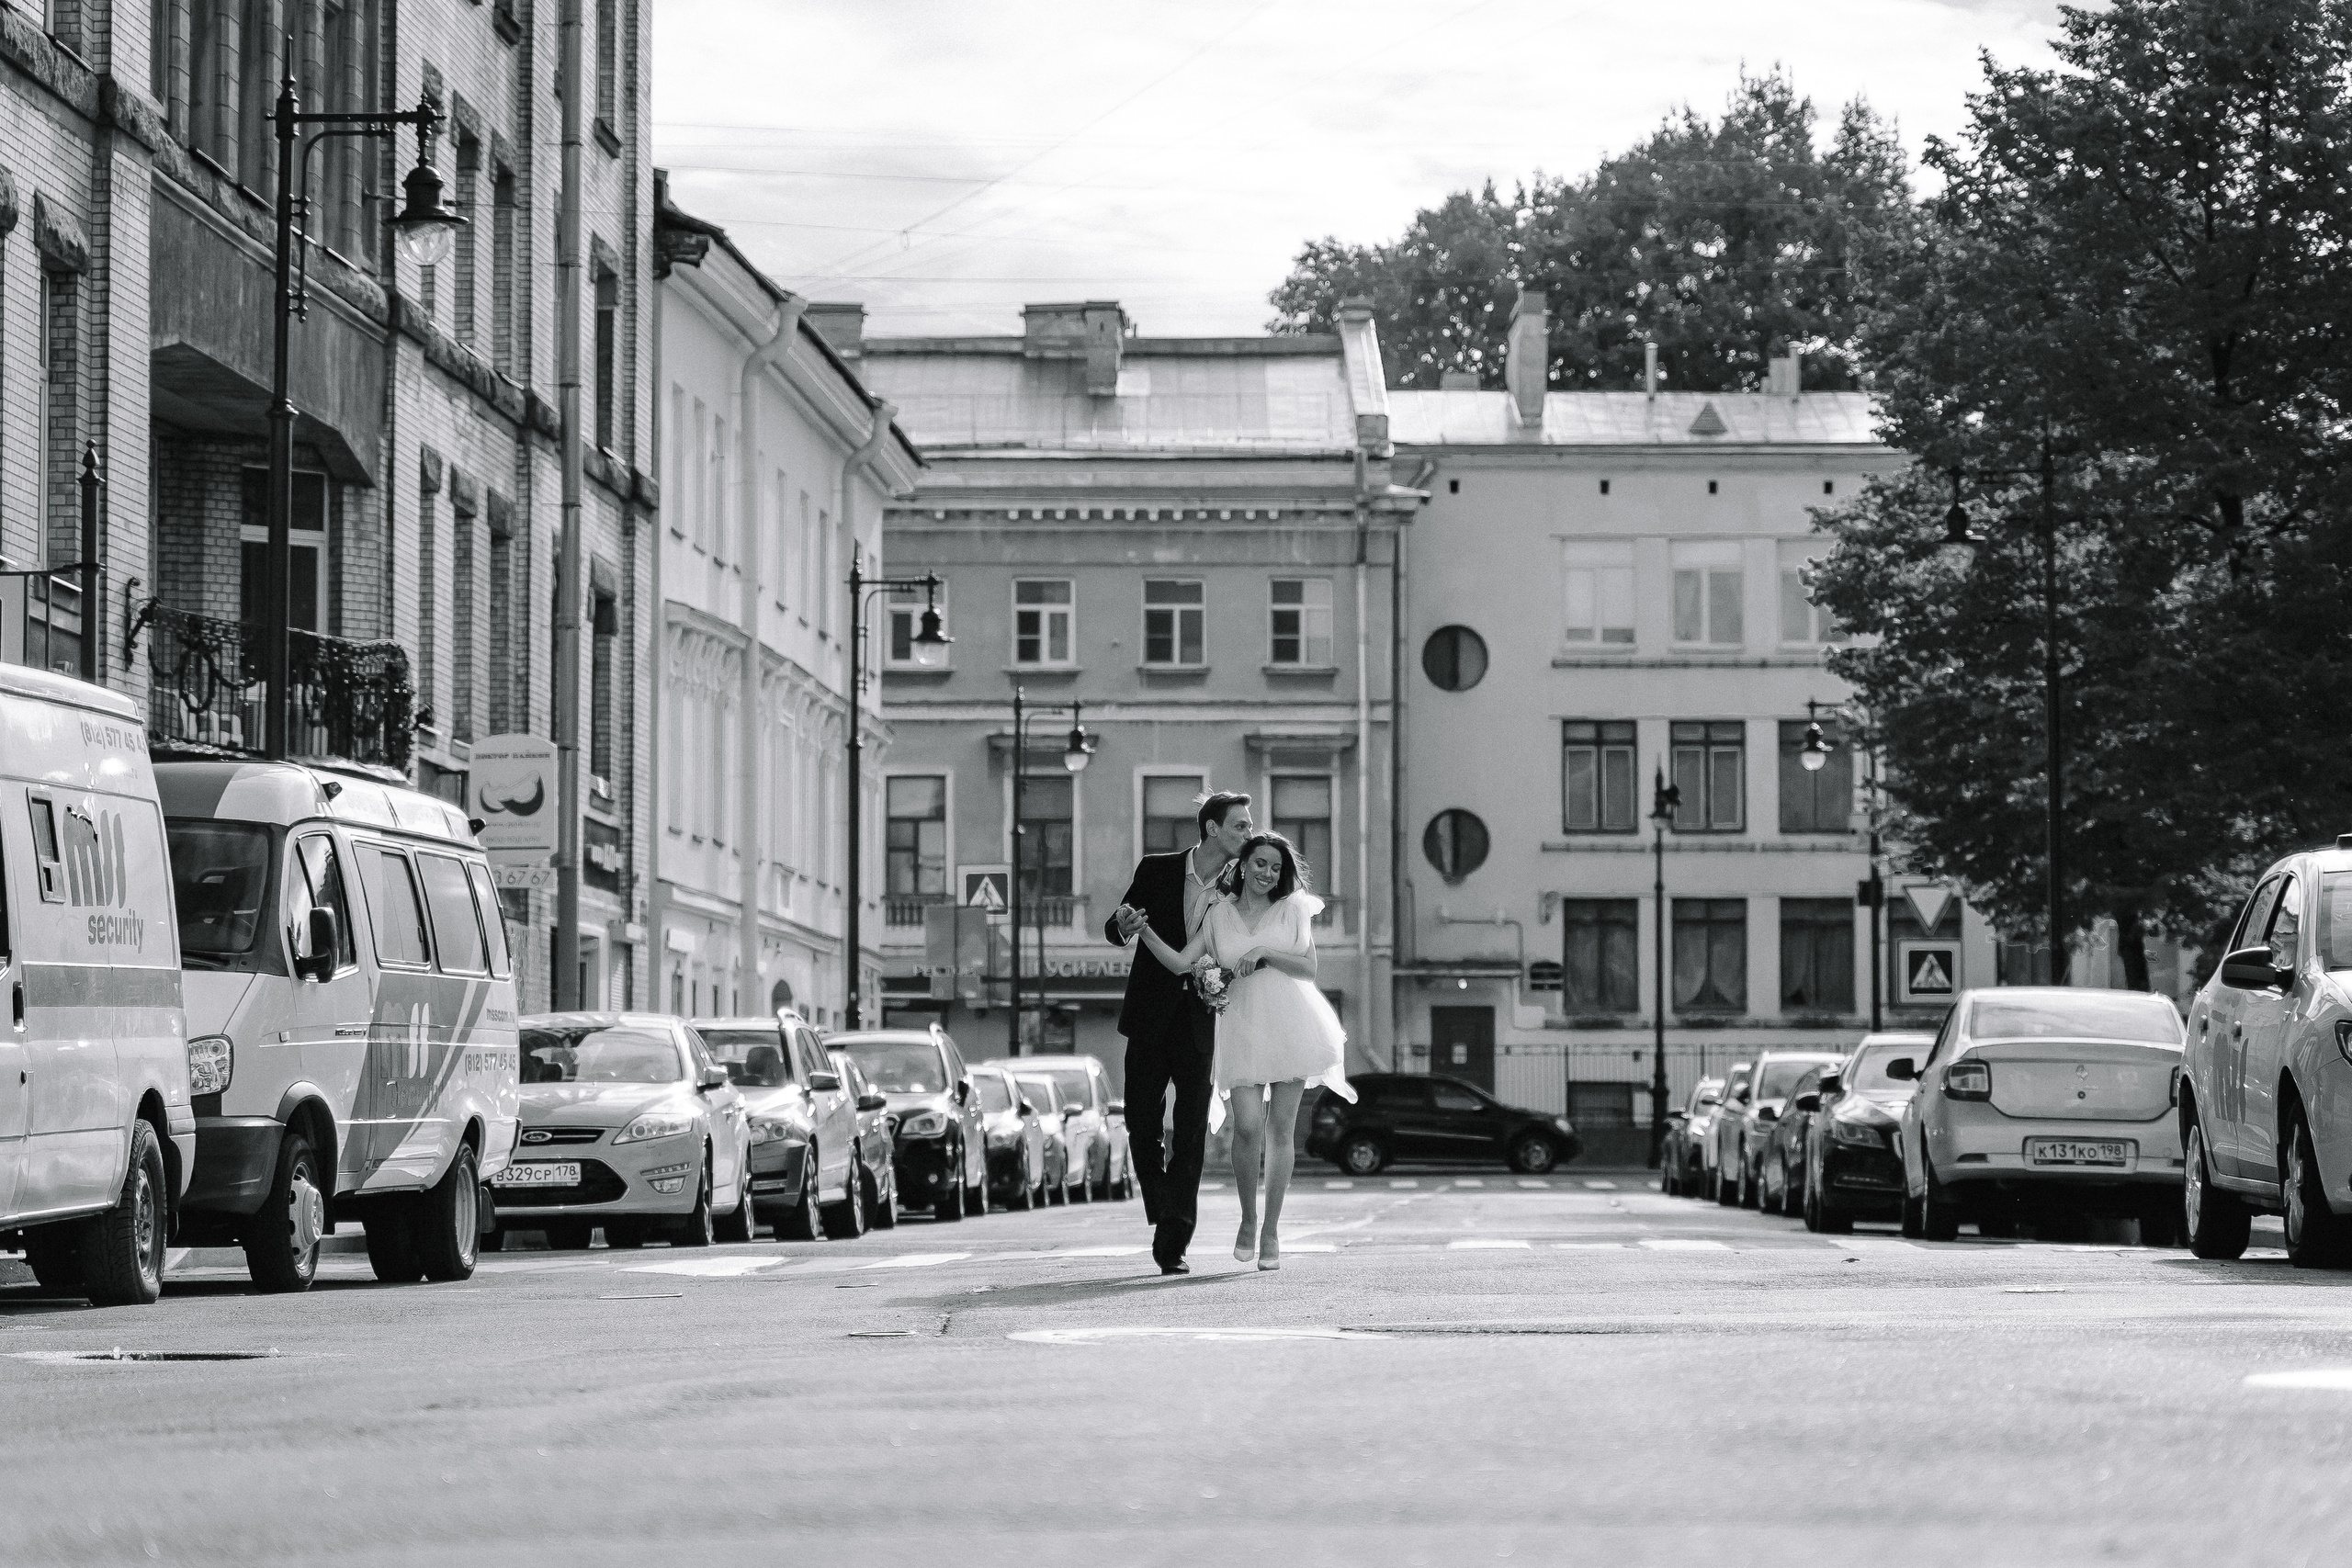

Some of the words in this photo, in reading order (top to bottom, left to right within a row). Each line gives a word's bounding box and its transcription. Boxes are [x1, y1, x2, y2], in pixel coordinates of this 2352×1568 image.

[81, 721, 106, 750] (812)
[105, 727, 121, 749] 577
[124, 732, 136, 752] 45
[507, 870, 526, 886] 67
[531, 871, 551, 886] 67
[88, 908, 143, 954] security
[465, 1054, 482, 1077] (812)
[484, 1054, 497, 1071] 577
[499, 1054, 507, 1071] 45
[508, 1055, 516, 1071] 45
[2100, 1145, 2121, 1156] 198
[556, 1166, 576, 1177] 178
